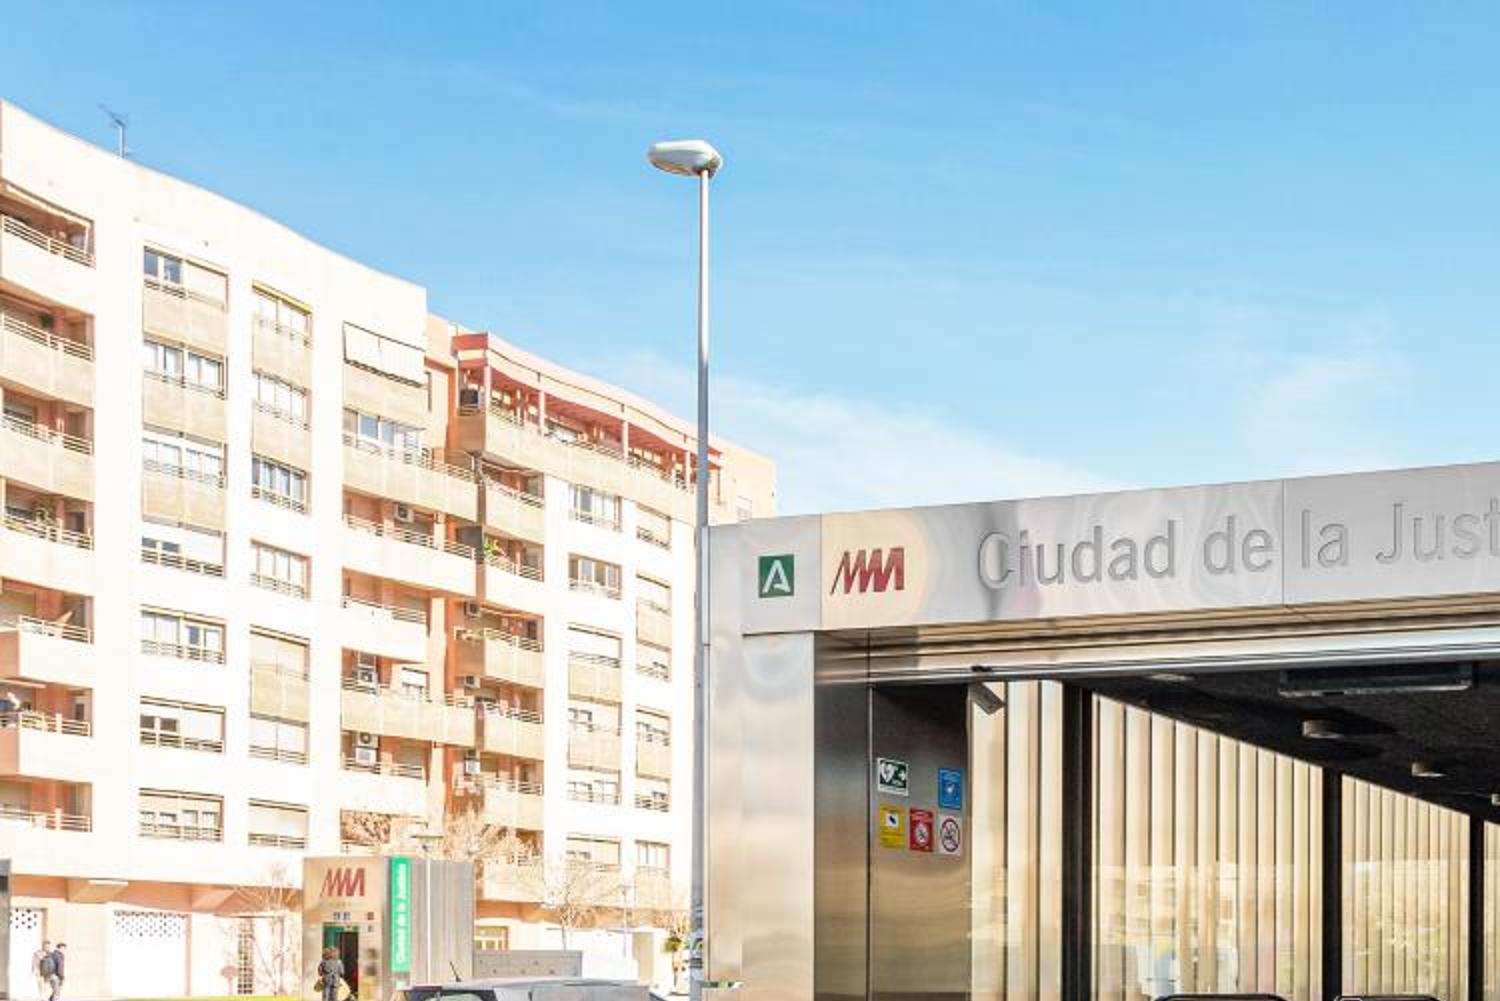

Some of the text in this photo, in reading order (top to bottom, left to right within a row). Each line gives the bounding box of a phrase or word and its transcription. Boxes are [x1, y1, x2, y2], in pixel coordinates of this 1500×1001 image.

[977, 519, 1175, 590] Ciudad
[1203, 514, 1273, 575] de
[1301, 508, 1350, 569] la
